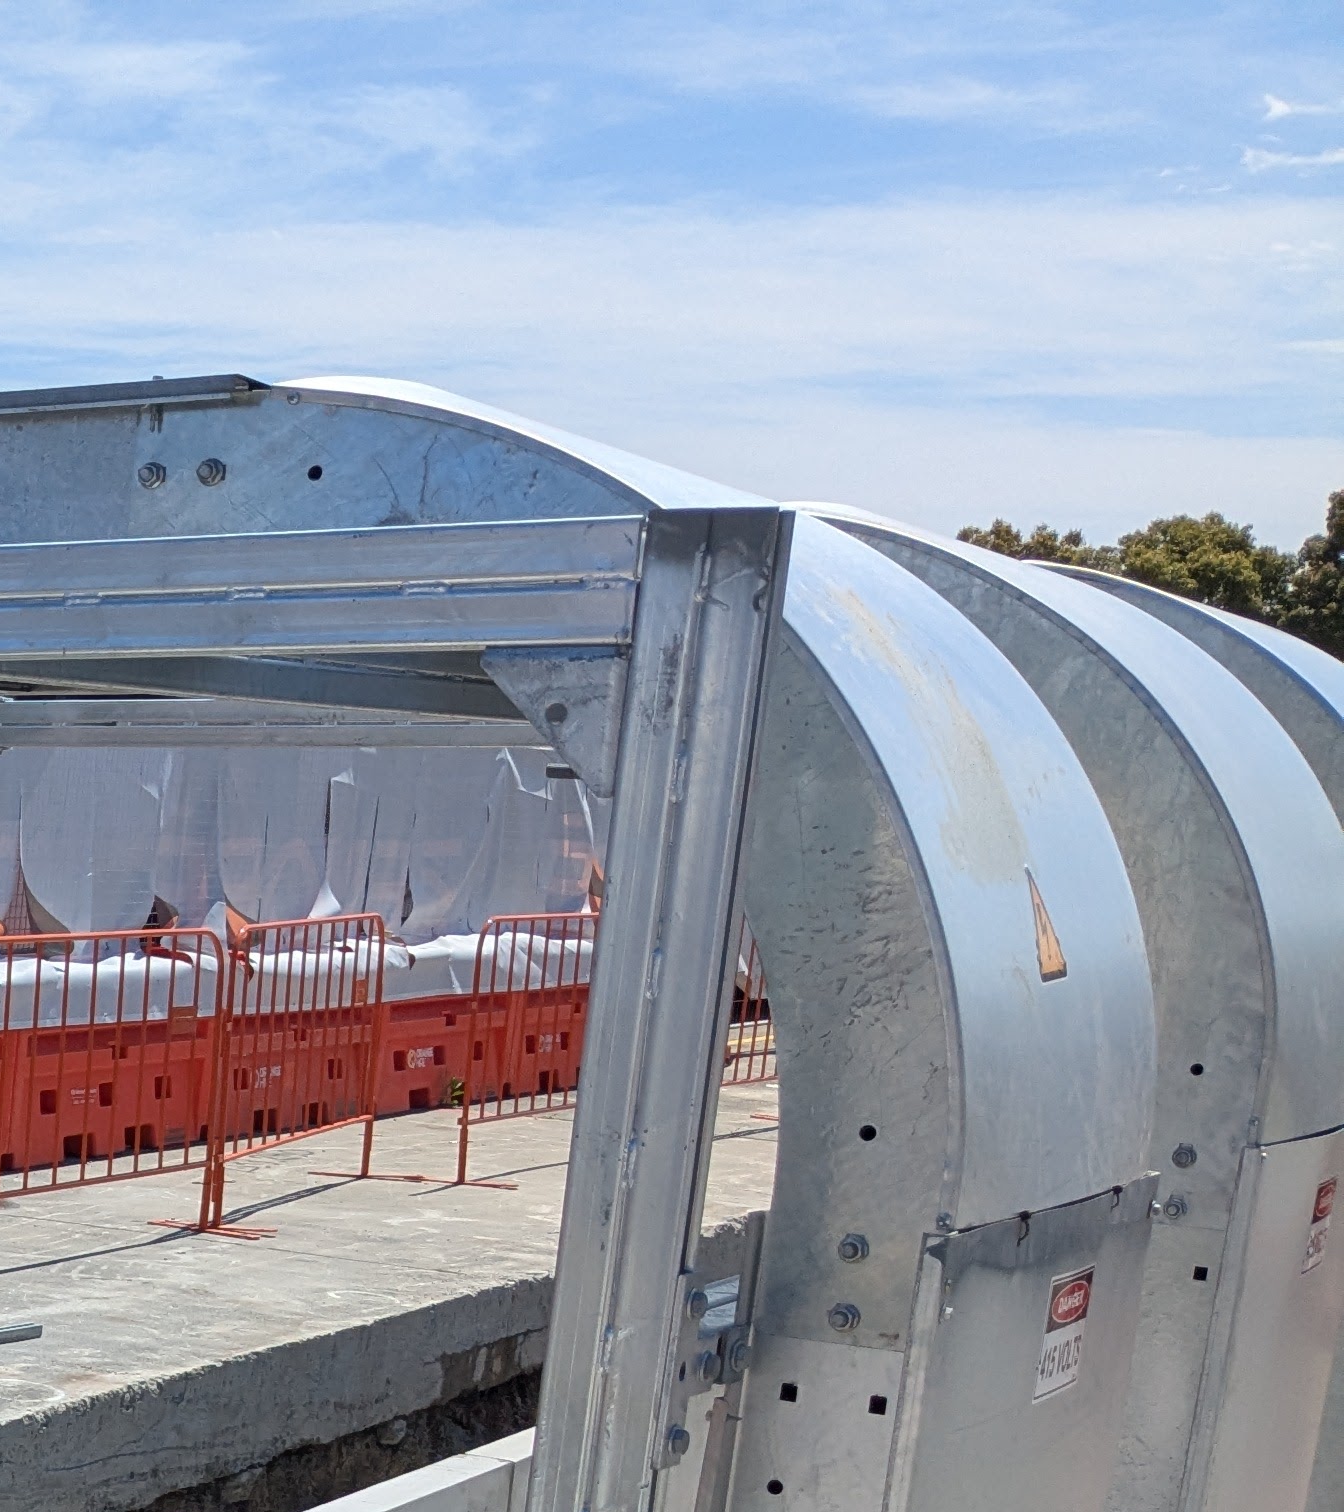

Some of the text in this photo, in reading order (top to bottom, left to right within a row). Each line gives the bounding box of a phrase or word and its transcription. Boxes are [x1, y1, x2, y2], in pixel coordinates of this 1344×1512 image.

[1057, 1288, 1085, 1314] DANGER
[1040, 1334, 1082, 1381] 415 VOLTS
